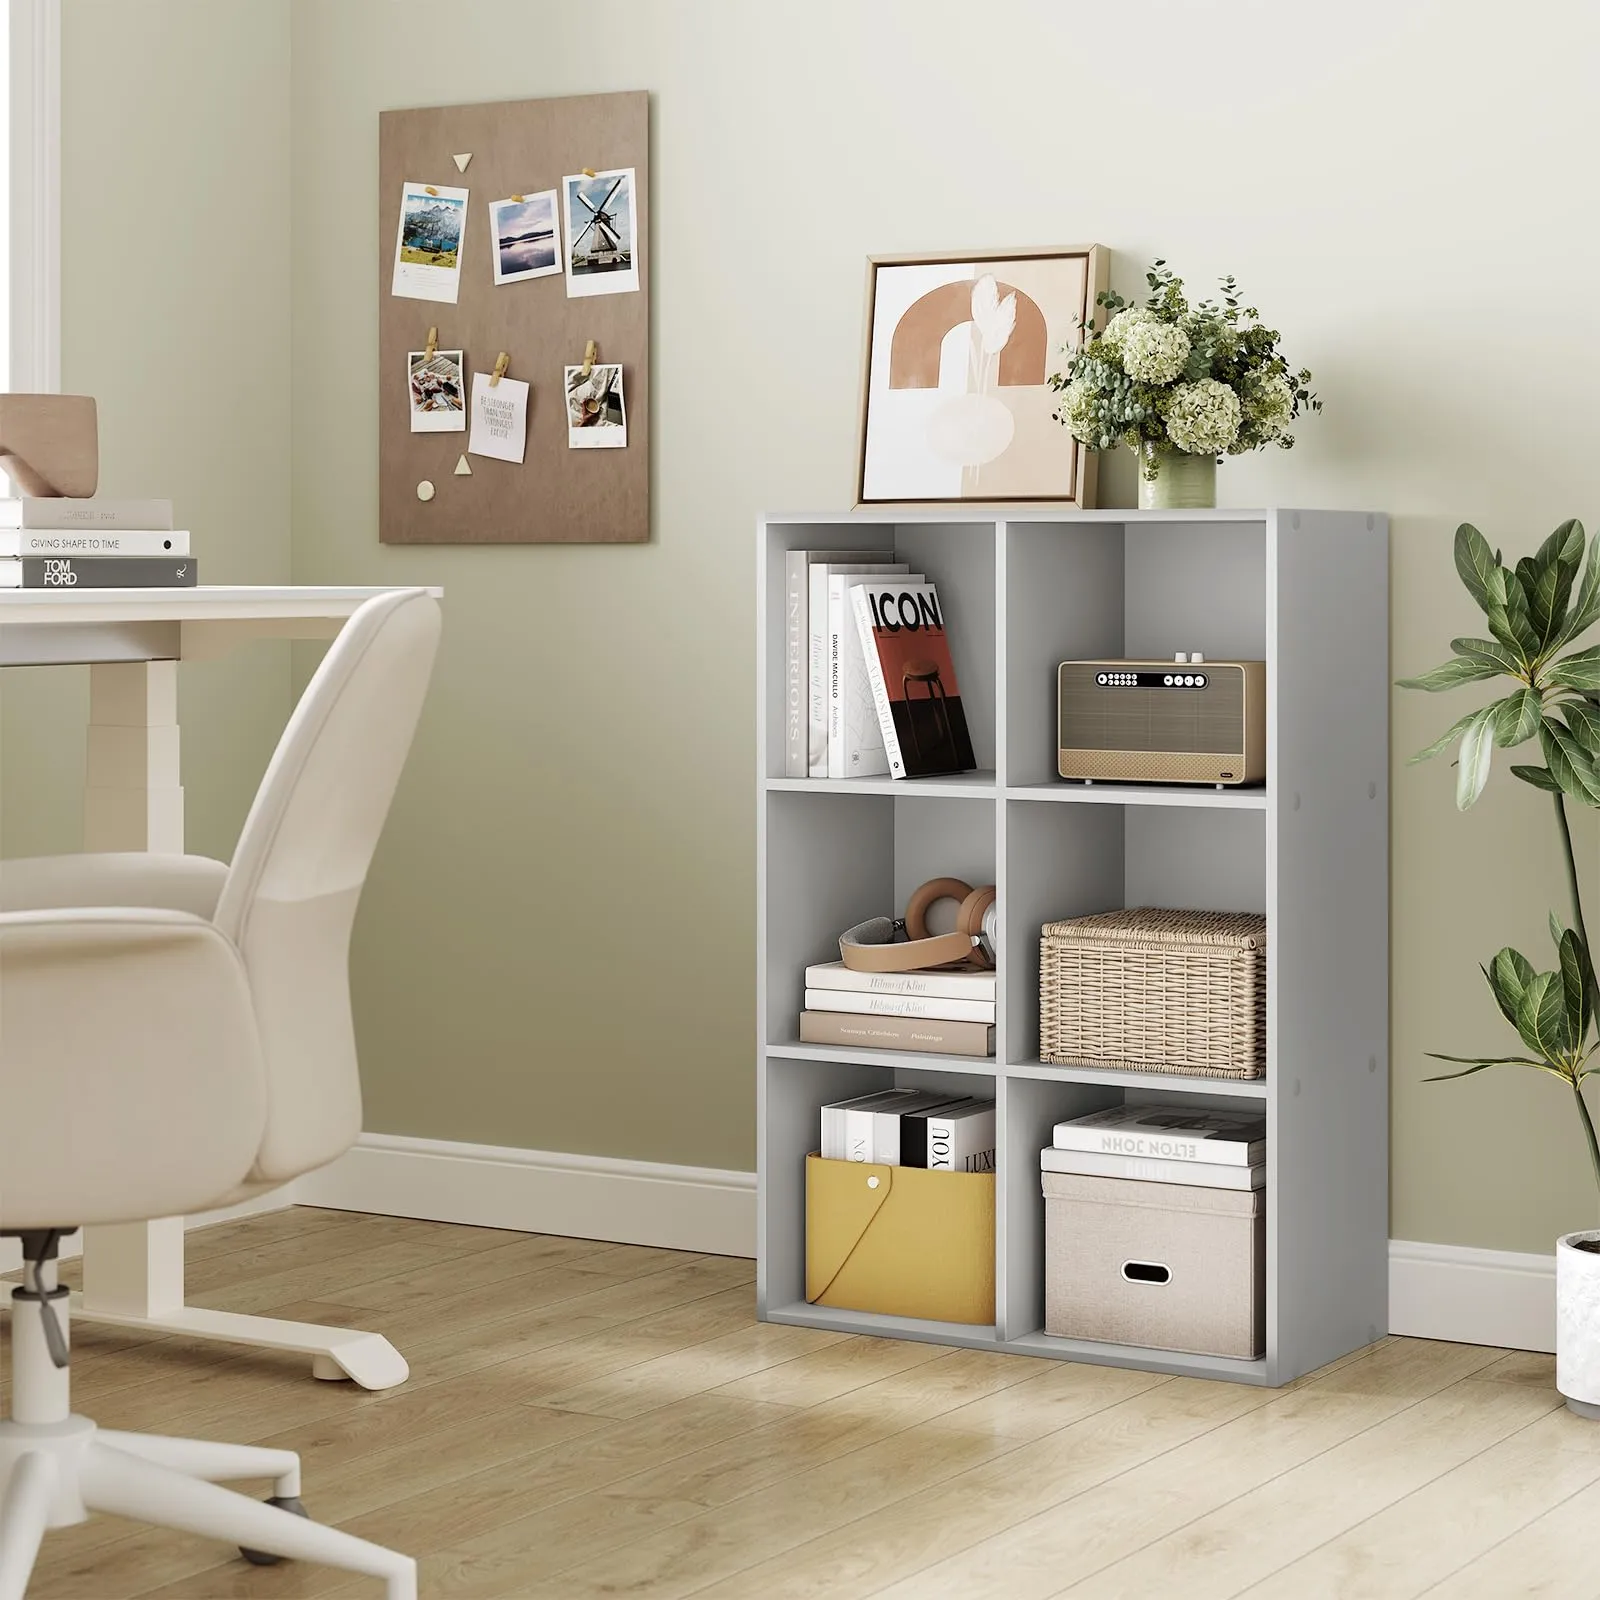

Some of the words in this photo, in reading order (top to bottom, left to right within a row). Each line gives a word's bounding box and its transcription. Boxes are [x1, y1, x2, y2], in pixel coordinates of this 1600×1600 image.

[31, 539, 60, 549] GIVING
[61, 539, 87, 549] SHAPE
[88, 539, 100, 549] TO
[102, 539, 120, 549] TIME
[44, 560, 71, 572] TOM
[44, 572, 77, 585] FORD
[869, 592, 942, 632] ICON
[790, 592, 799, 741] INTERIORS
[932, 1127, 950, 1168] YOU
[1102, 1137, 1144, 1152] JOHN
[1149, 1141, 1196, 1158] ELTON
